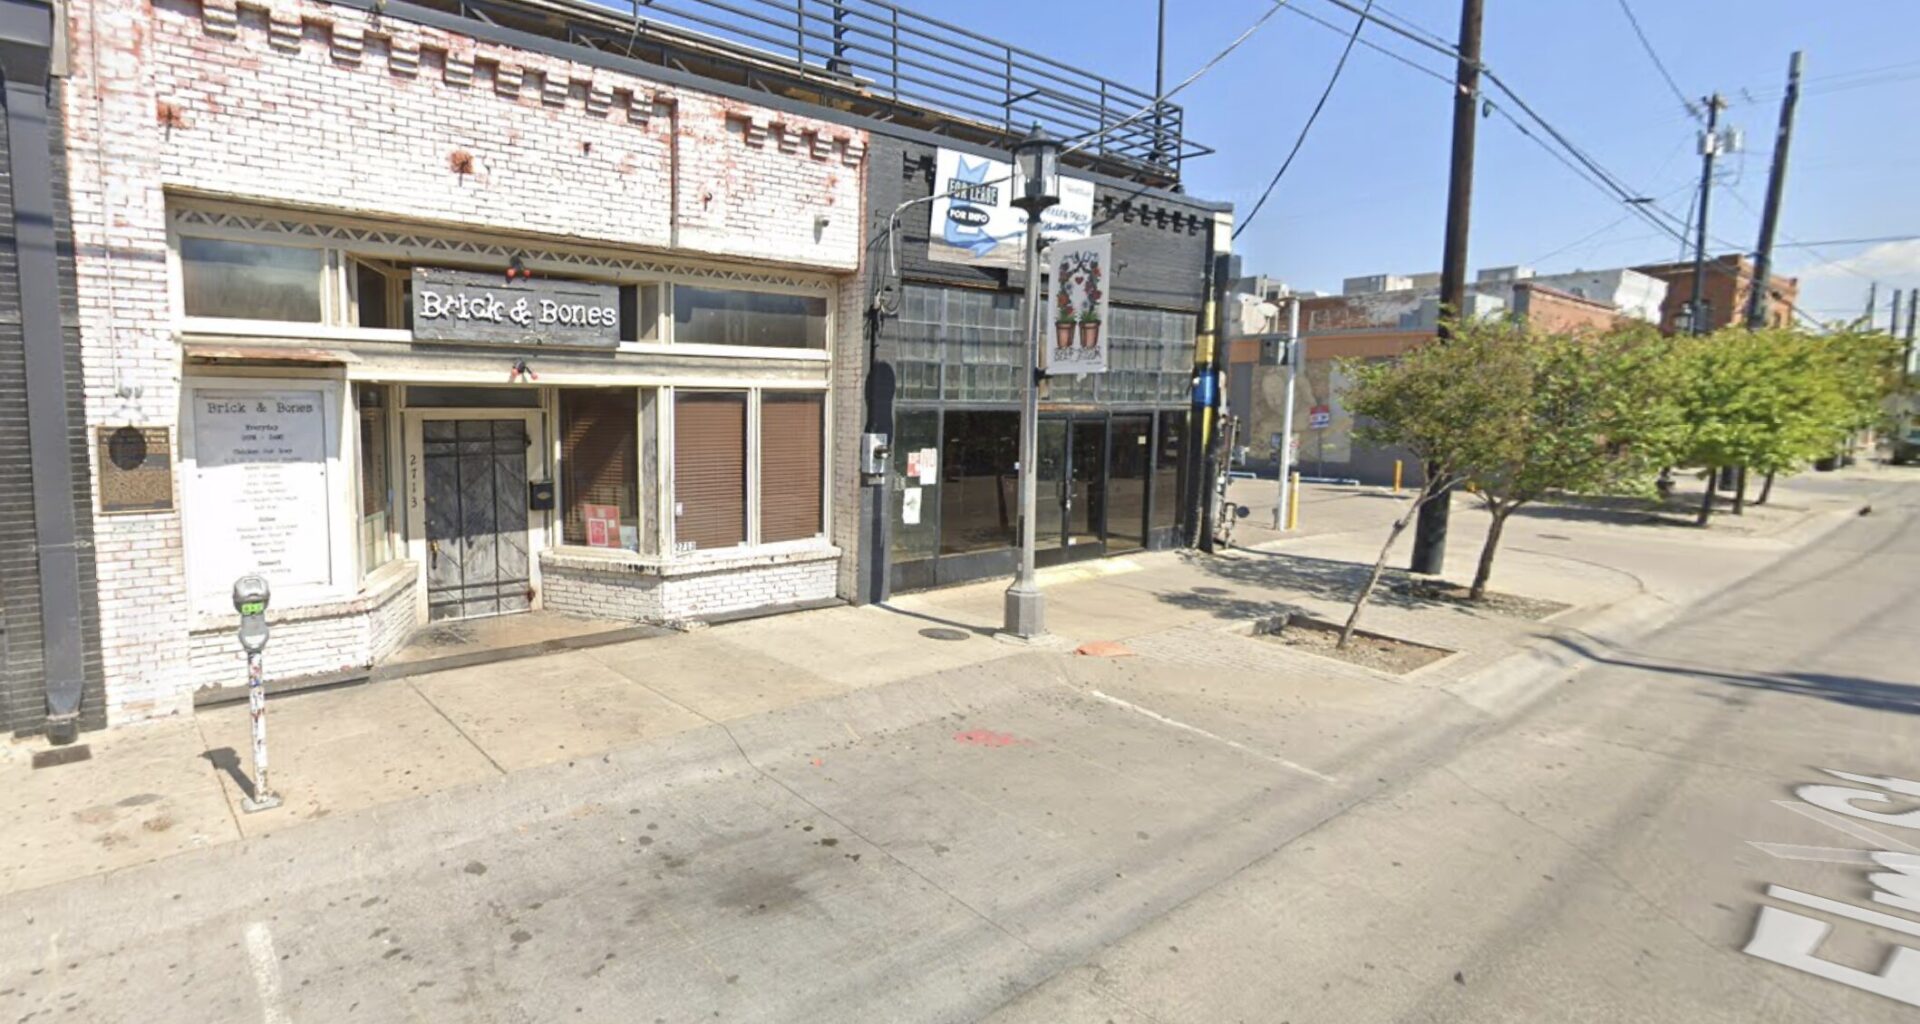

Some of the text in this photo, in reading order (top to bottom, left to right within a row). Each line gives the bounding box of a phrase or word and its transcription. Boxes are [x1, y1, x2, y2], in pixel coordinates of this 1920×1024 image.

[949, 180, 968, 200] FOR
[949, 209, 988, 223] FOR INFO
[419, 290, 617, 327] Brick & Bones
[207, 402, 313, 414] Brick & Bones
